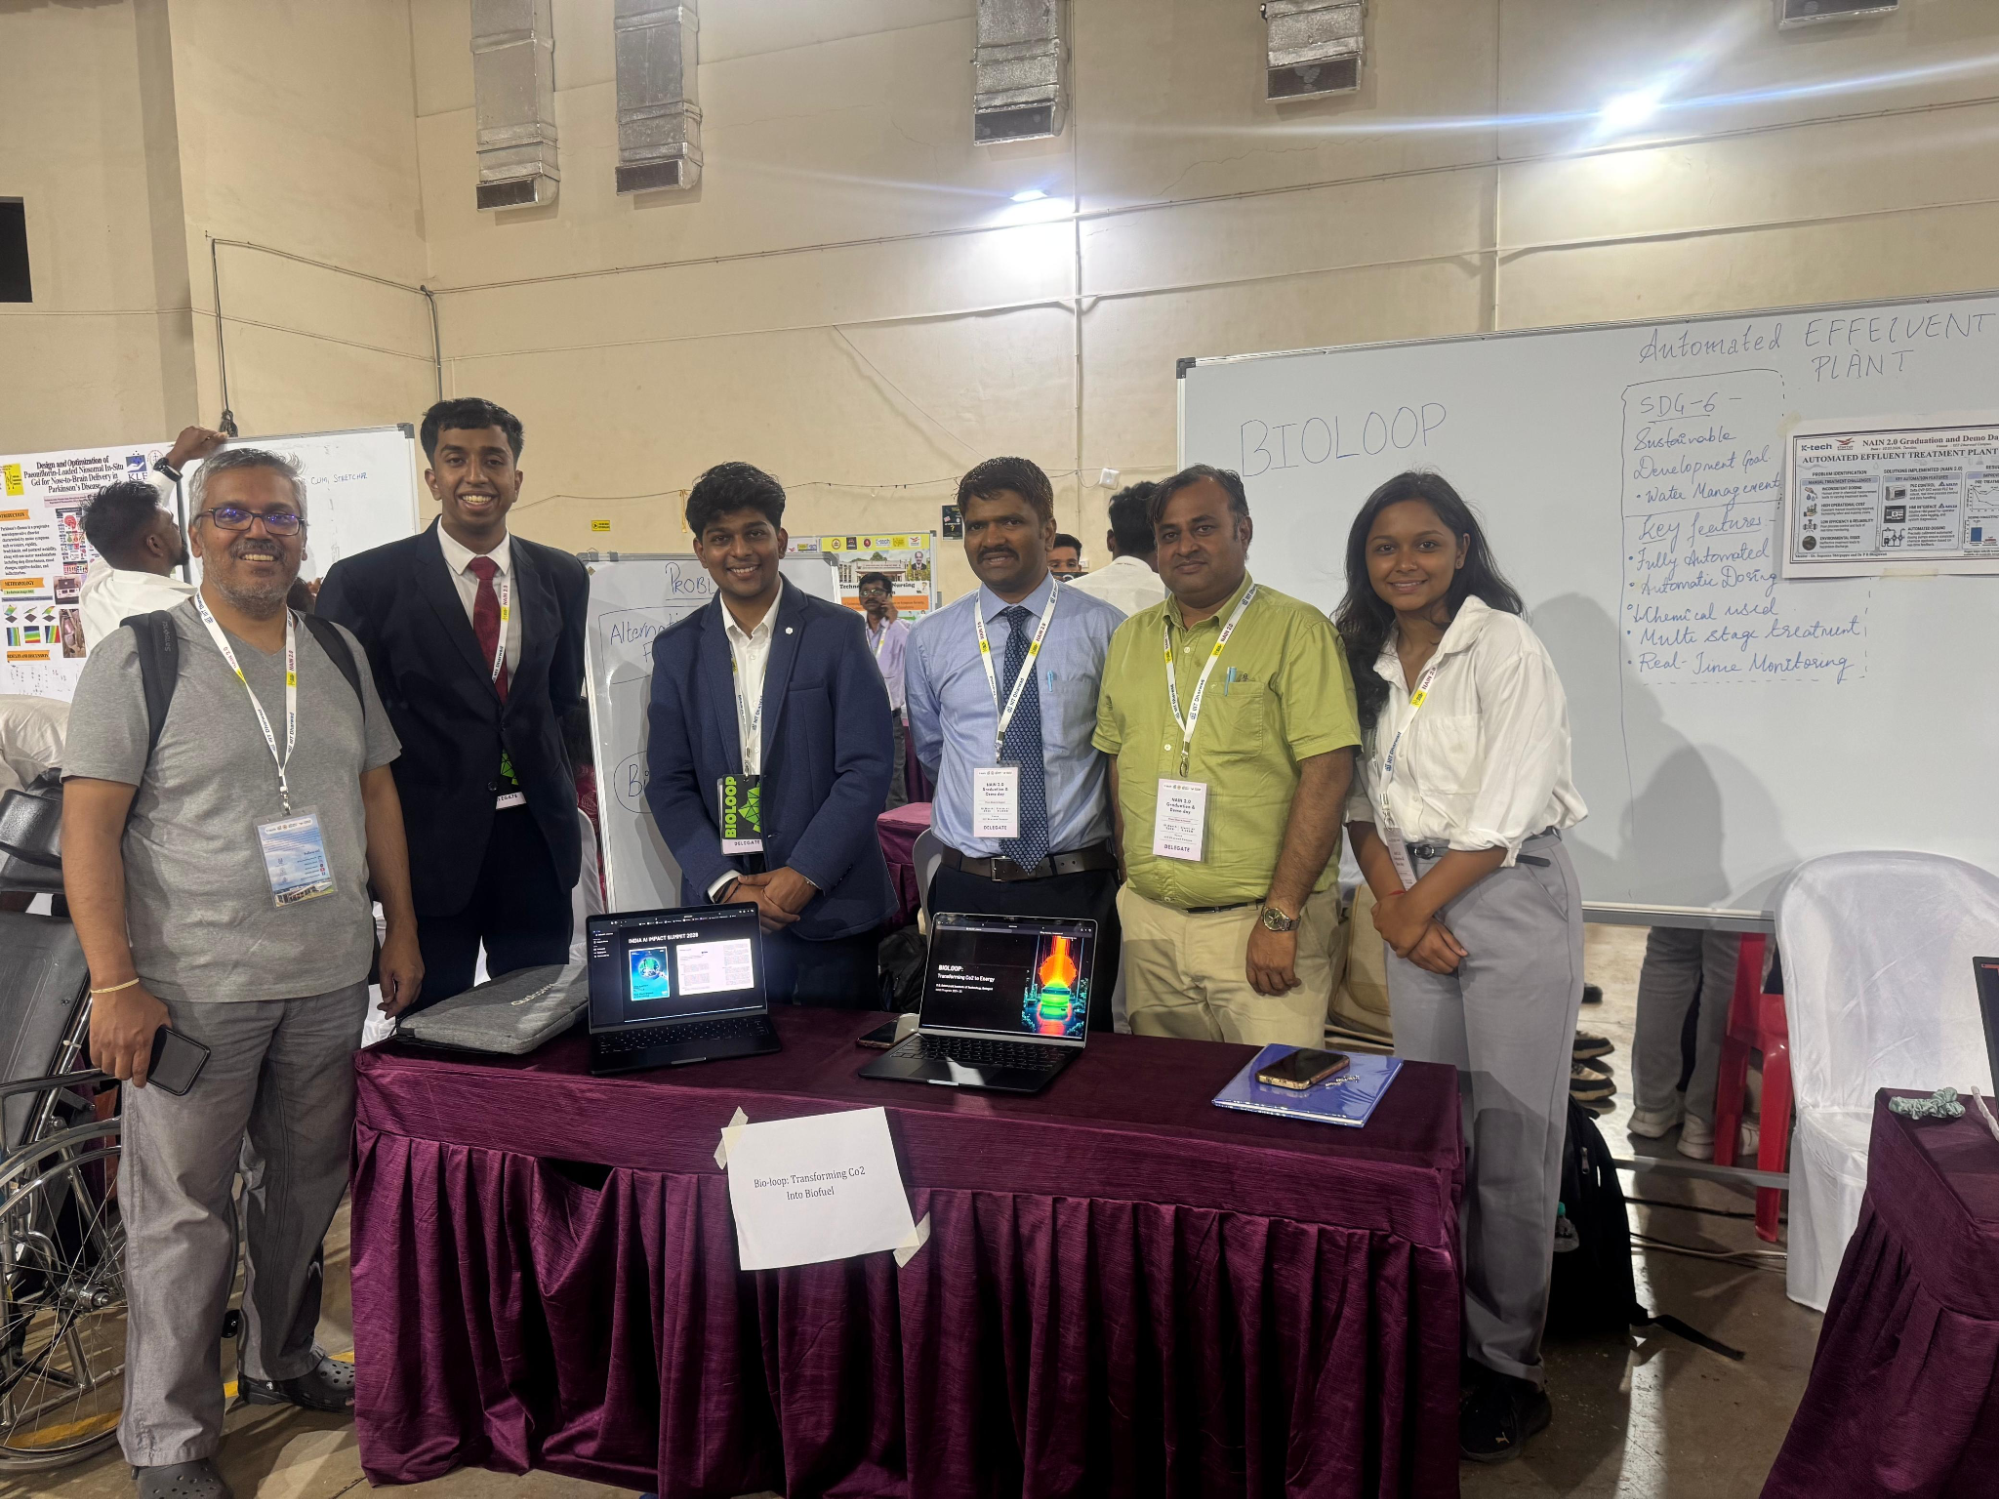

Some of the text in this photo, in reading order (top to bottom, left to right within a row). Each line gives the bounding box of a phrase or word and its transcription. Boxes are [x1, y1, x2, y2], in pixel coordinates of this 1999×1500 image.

[1639, 322, 1782, 364] Automated
[1811, 349, 1914, 382] PLANT
[1241, 402, 1446, 476] BIOLOOP
[1862, 438, 1885, 447] NAIN
[1886, 438, 1898, 446] 2.0
[1899, 436, 1944, 445] Graduation
[1945, 435, 1961, 443] and
[1962, 434, 1986, 442] Demo
[1987, 433, 1999, 442] Da
[1801, 443, 1833, 452] K-tech
[1802, 447, 1999, 464] AUTOMATED EFFLUENT TREATMENT PLANT
[36, 461, 56, 470] Design
[56, 460, 67, 468] and
[68, 457, 102, 468] Optimization
[105, 462, 124, 472] In-Situ
[31, 478, 41, 486] Gel
[42, 477, 50, 486] for
[88, 473, 112, 482] Delivery
[128, 472, 148, 482] KLE
[48, 484, 81, 494] Parkinson's
[1221, 630, 1230, 642] NAIN
[1013, 678, 1024, 698] Dharwad
[1422, 674, 1432, 690] NAIN
[725, 776, 737, 838] BIOLOOP
[1164, 844, 1190, 852] DELEGATE
[754, 1166, 866, 1189] Bio-loop: Transforming Co2
[786, 1186, 835, 1200] Into Biofuel
